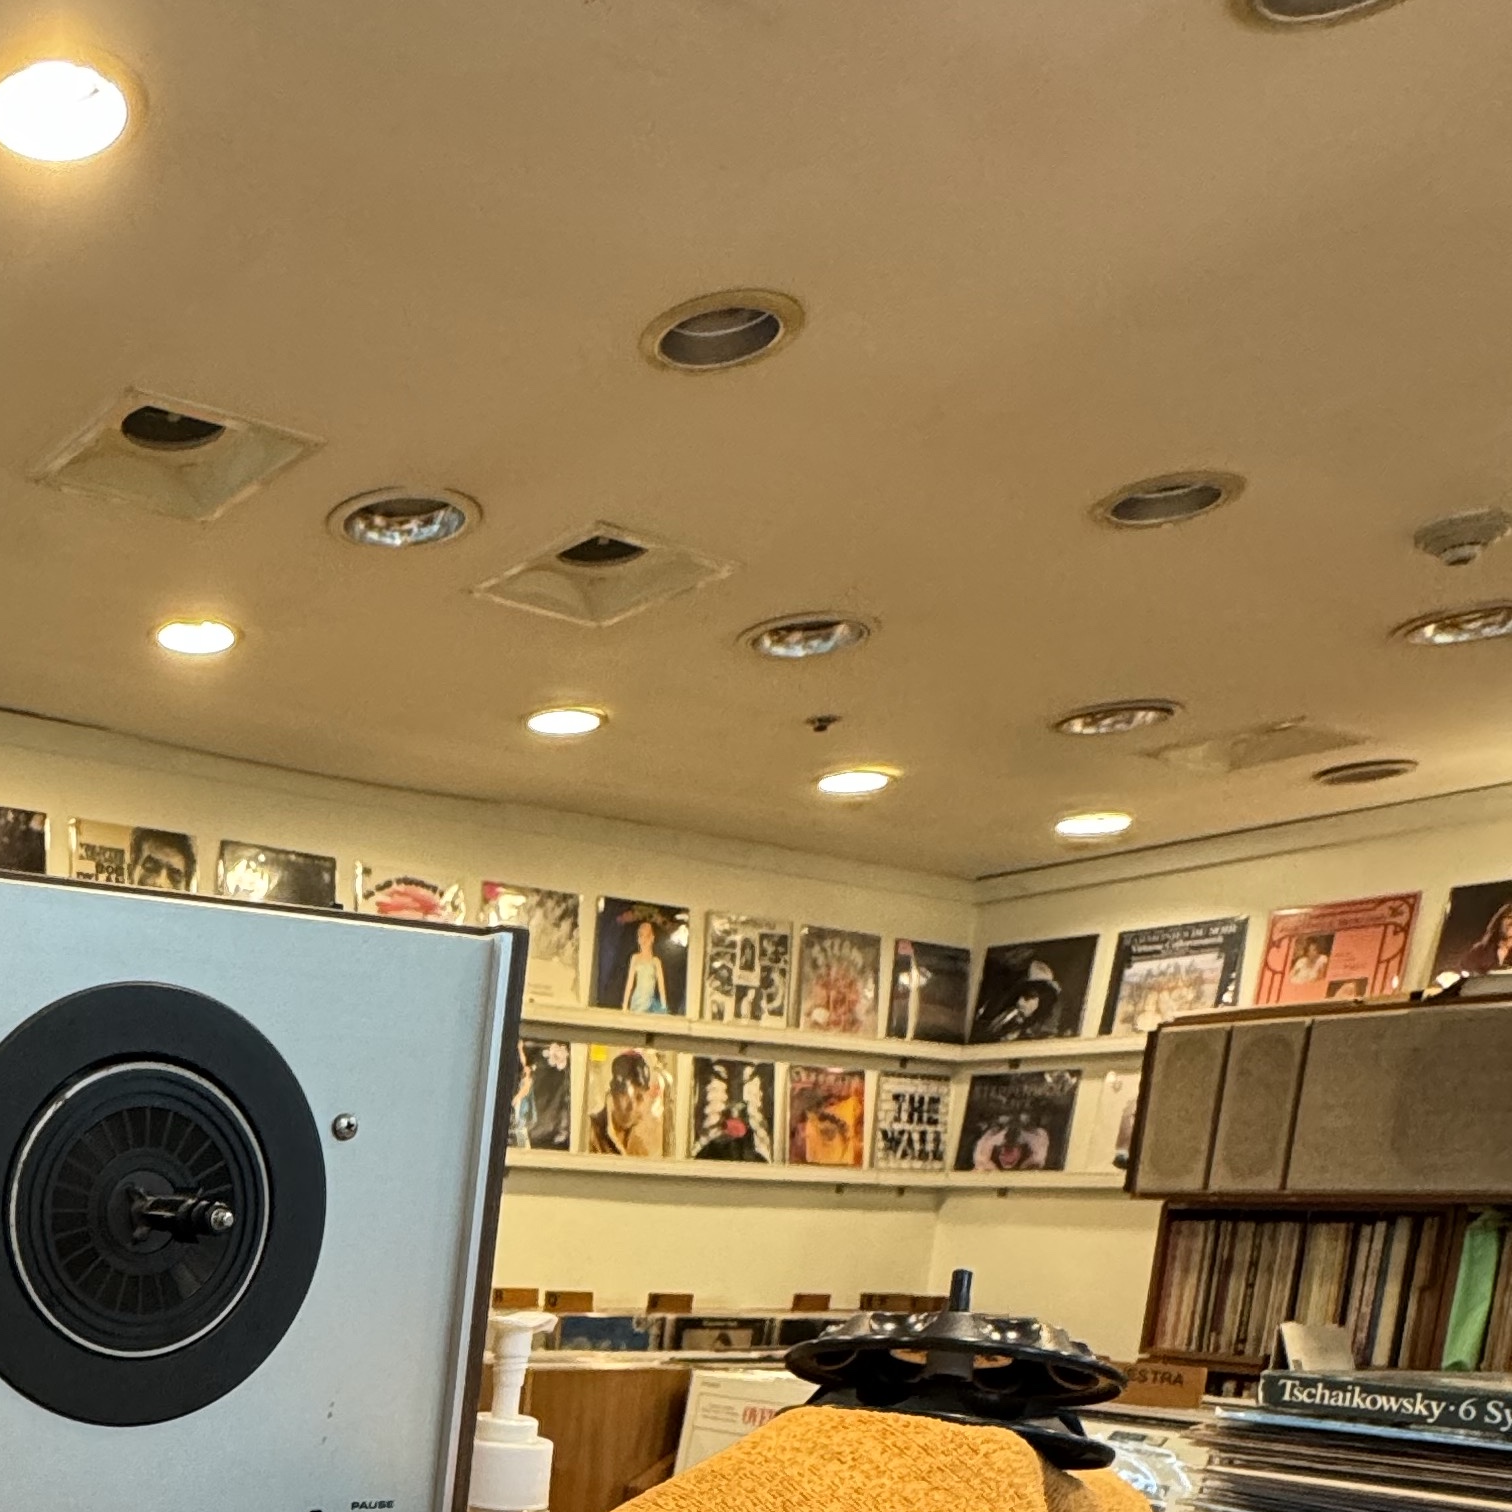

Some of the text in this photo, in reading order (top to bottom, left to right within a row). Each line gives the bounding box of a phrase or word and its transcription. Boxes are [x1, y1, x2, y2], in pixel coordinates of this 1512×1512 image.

[891, 1092, 941, 1125] THE
[1277, 1379, 1446, 1423] Tschaikowsky
[1458, 1397, 1479, 1421] 6
[350, 1500, 395, 1511] PAUSE
